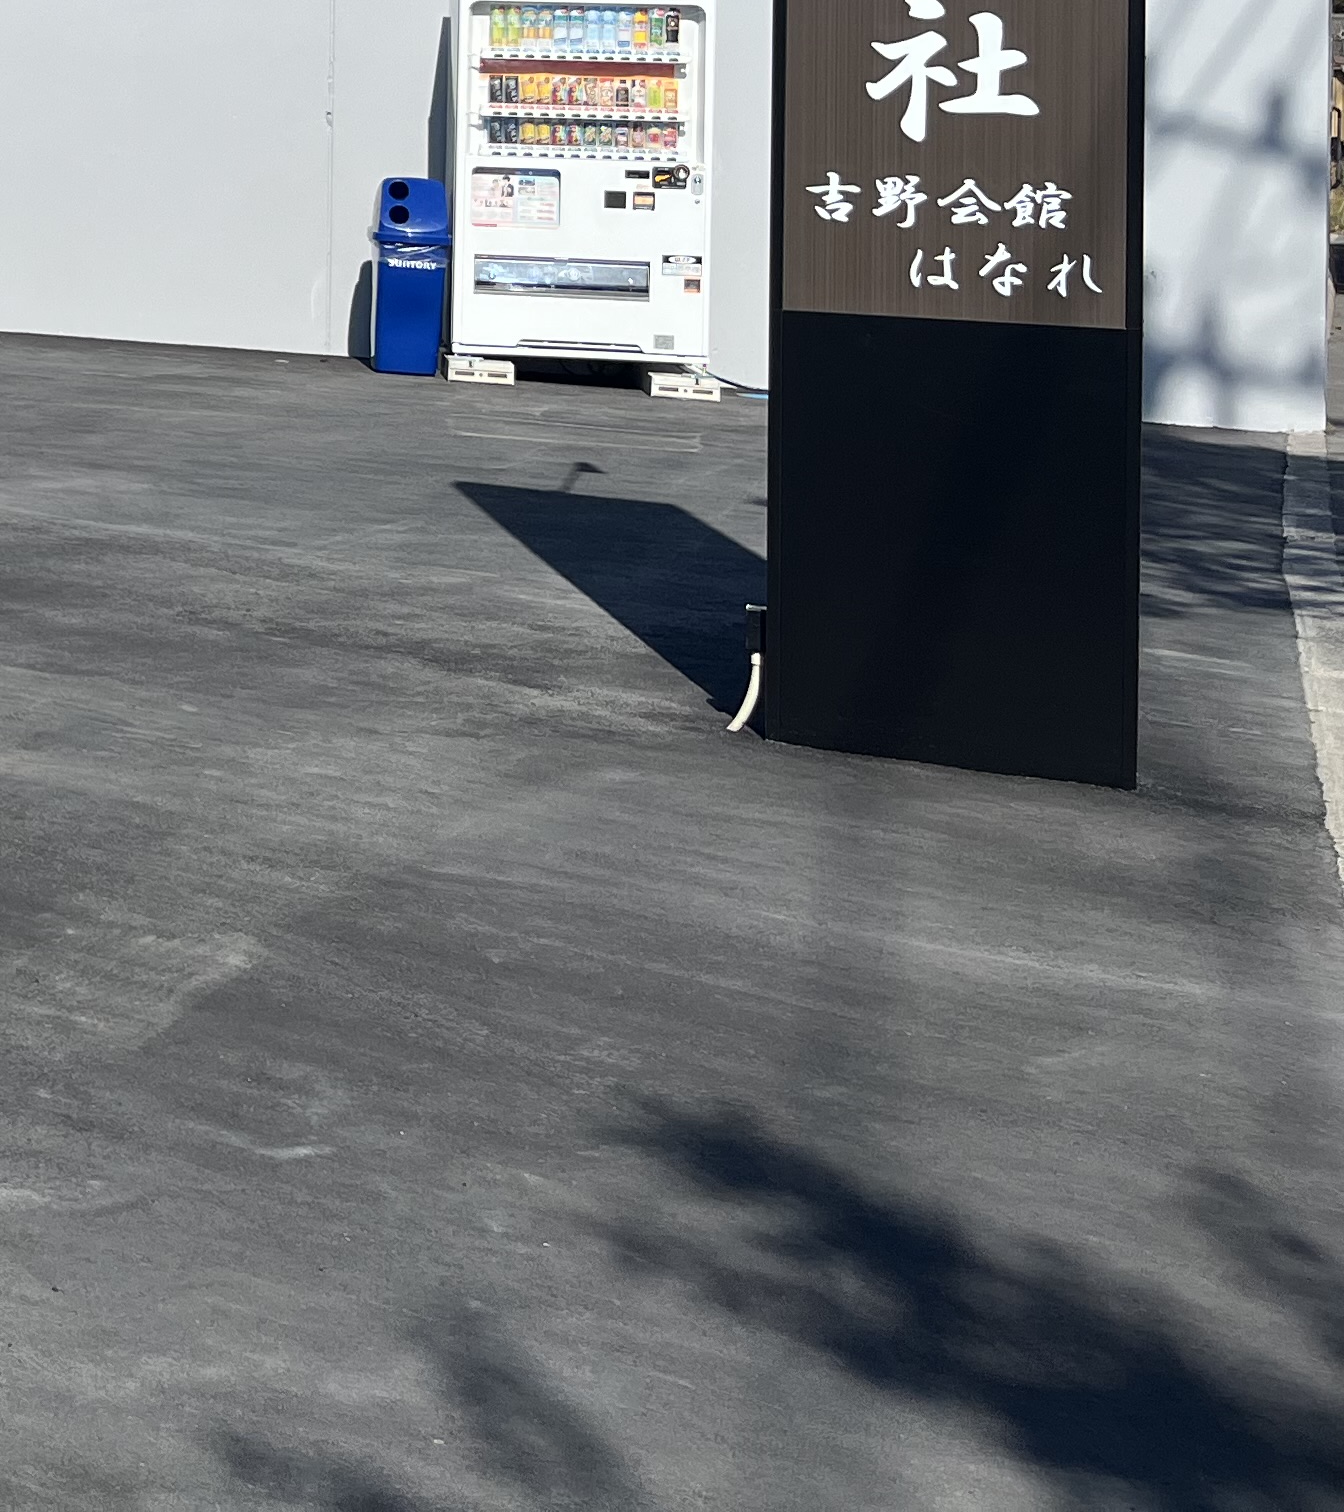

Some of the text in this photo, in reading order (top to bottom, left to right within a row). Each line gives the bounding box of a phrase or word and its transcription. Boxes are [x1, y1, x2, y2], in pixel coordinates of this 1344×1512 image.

[805, 170, 1073, 230] 吉野会館
[386, 257, 438, 271] SUNTORY
[908, 241, 1104, 298] はなれ
